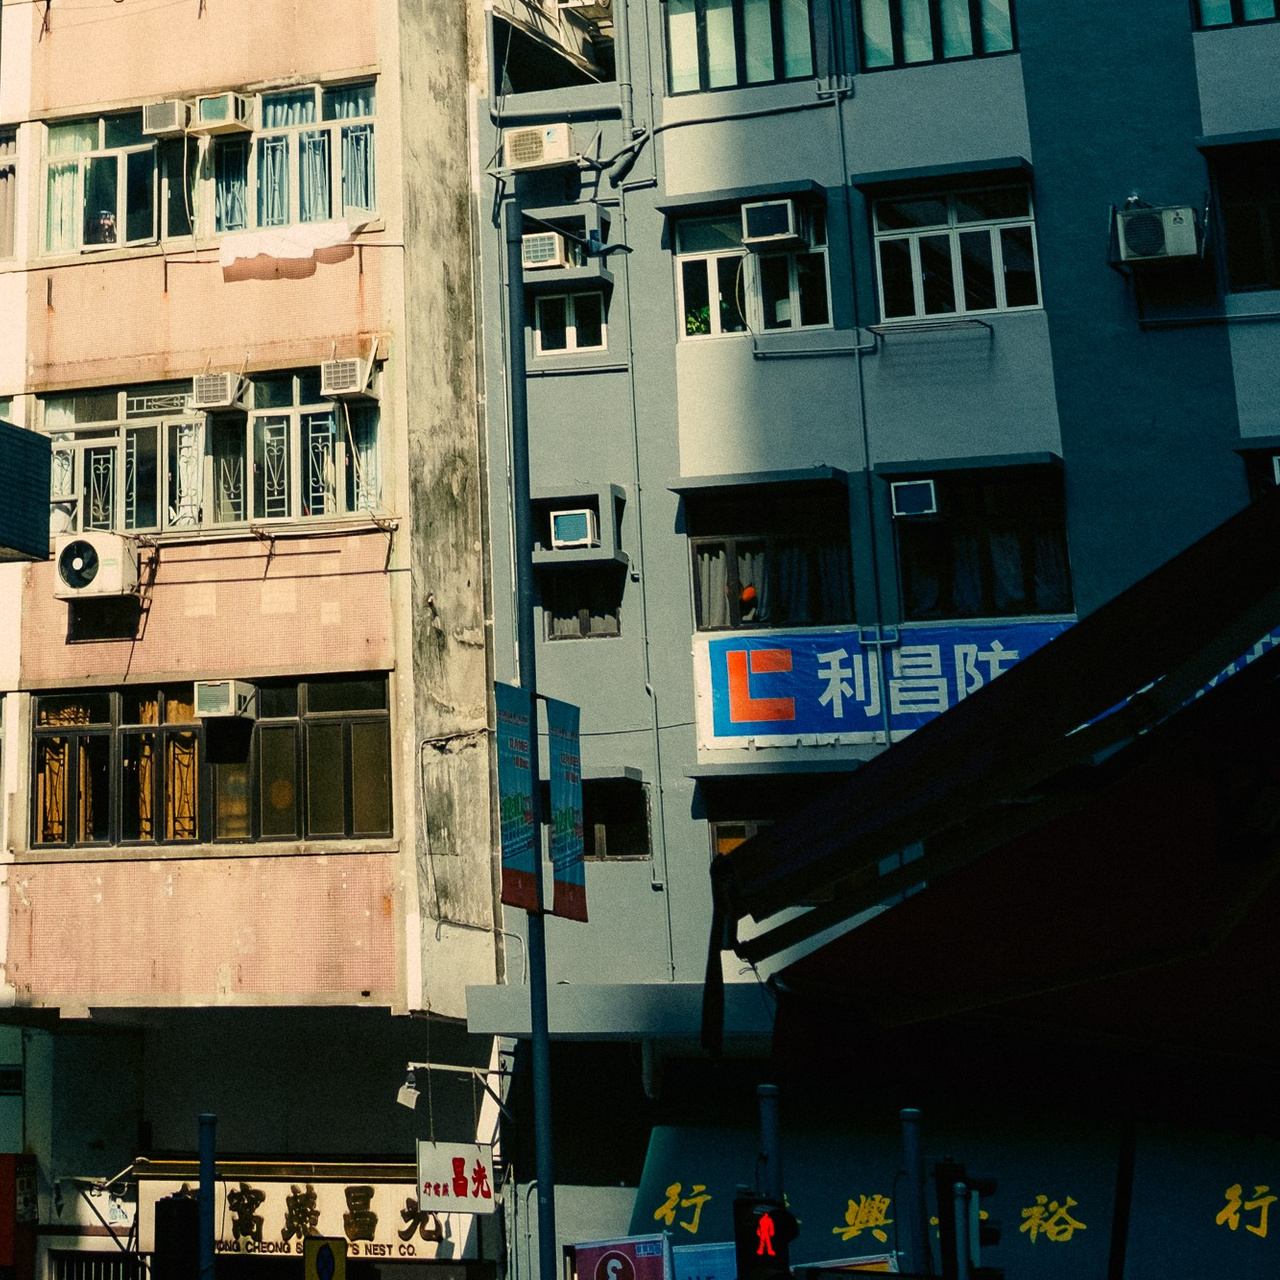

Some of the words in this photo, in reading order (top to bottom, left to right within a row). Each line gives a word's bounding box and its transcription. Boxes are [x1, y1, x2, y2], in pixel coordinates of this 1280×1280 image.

[245, 1241, 291, 1254] CHEONG
[365, 1244, 393, 1257] NEST
[399, 1245, 417, 1257] CO.
